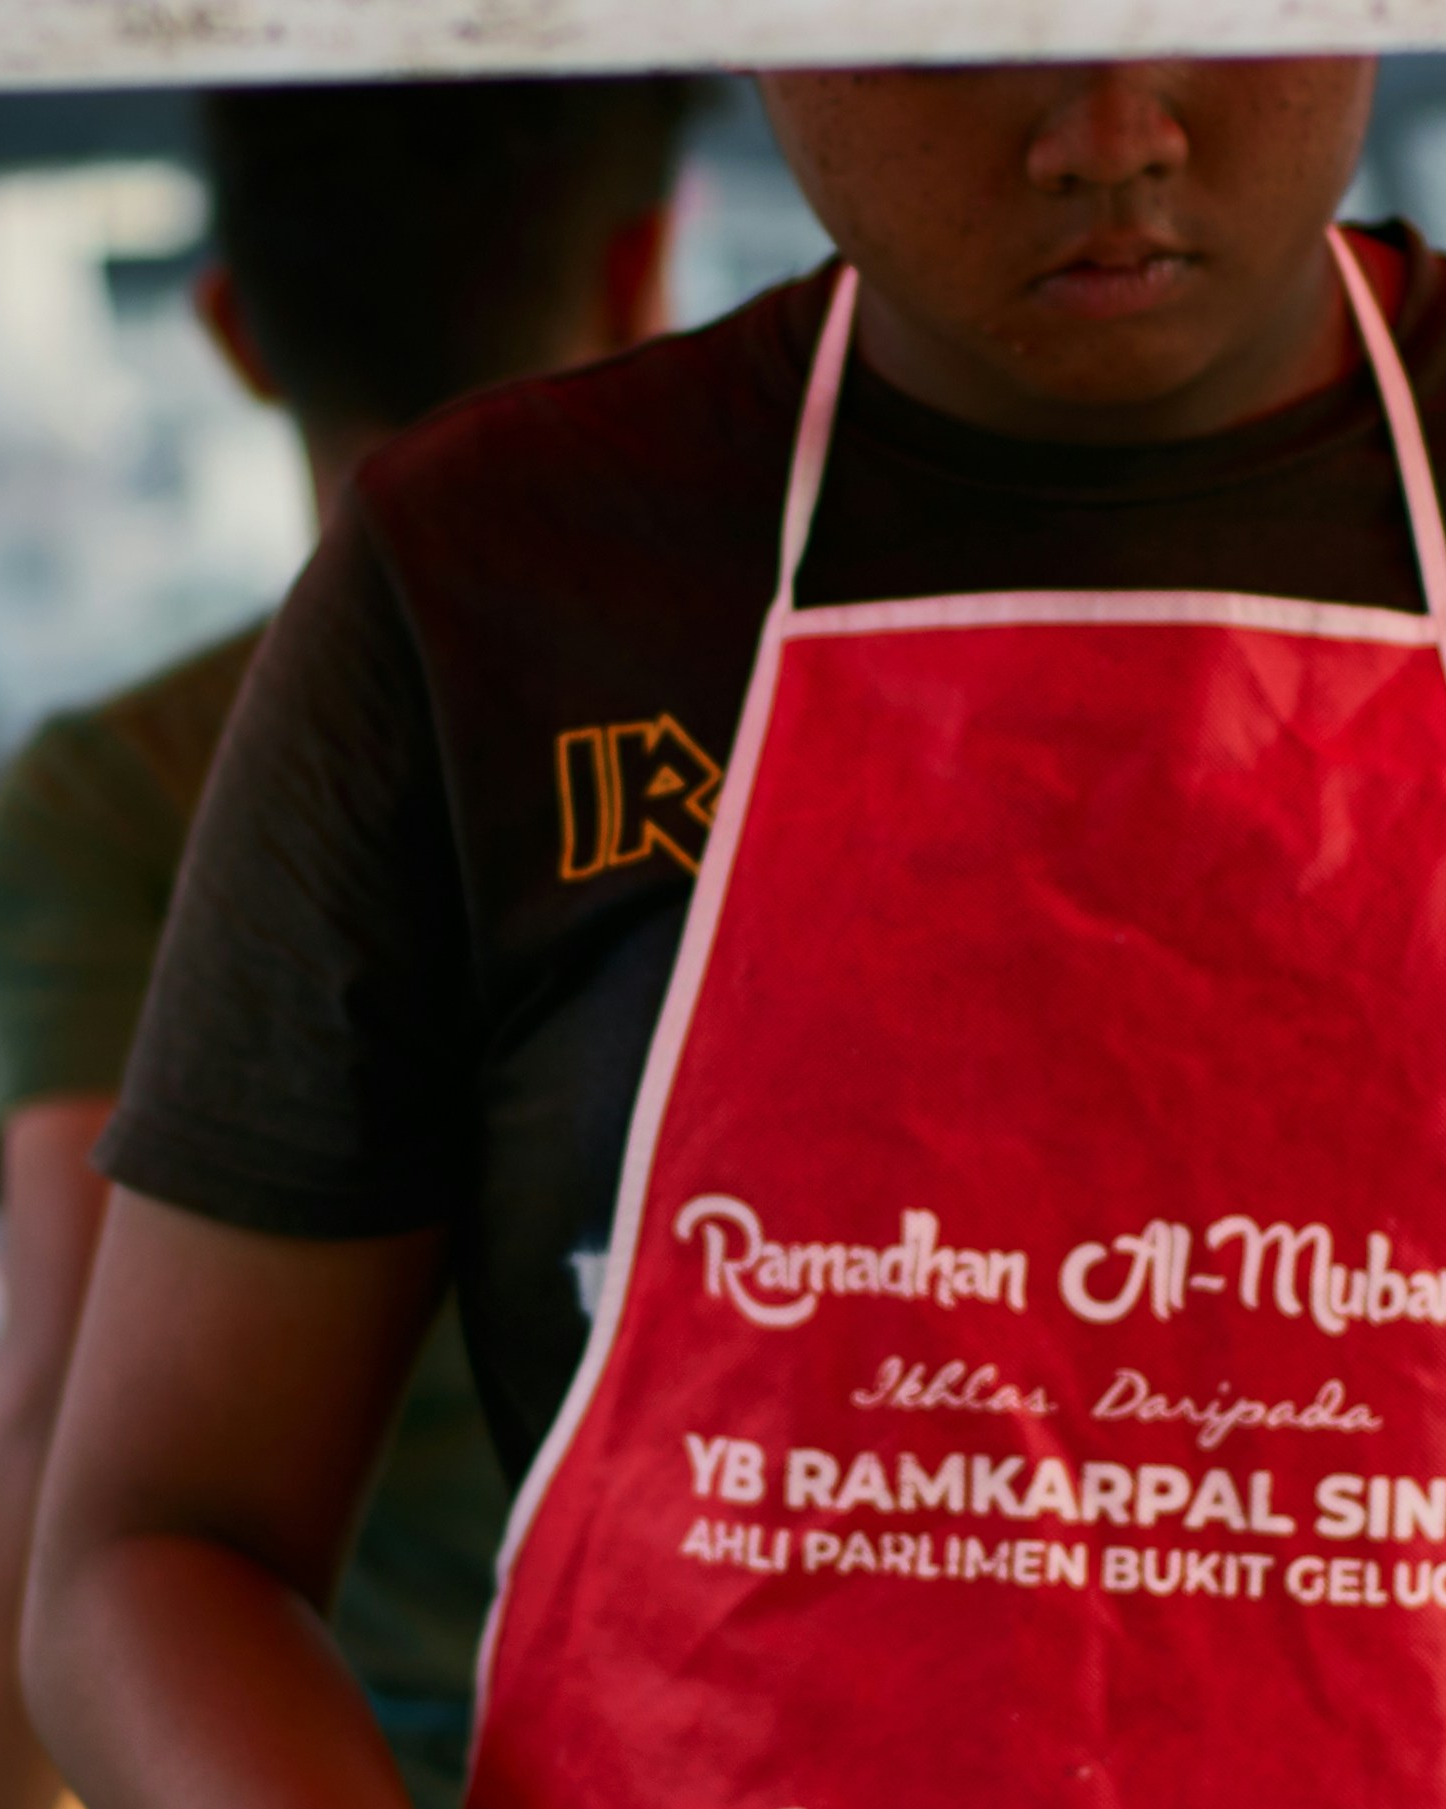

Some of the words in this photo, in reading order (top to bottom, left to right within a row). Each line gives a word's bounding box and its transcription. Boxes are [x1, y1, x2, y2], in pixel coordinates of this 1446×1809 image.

[674, 1193, 1028, 1330] Ramadhan
[852, 1354, 1057, 1418] Ikhlas
[1091, 1367, 1384, 1450] Daripada
[684, 1433, 765, 1504] YB
[784, 1447, 1296, 1537] RAMKARPAL
[681, 1518, 791, 1572] AHLI
[802, 1529, 1089, 1589] PARLIMEN
[1102, 1546, 1276, 1598] BUKIT
